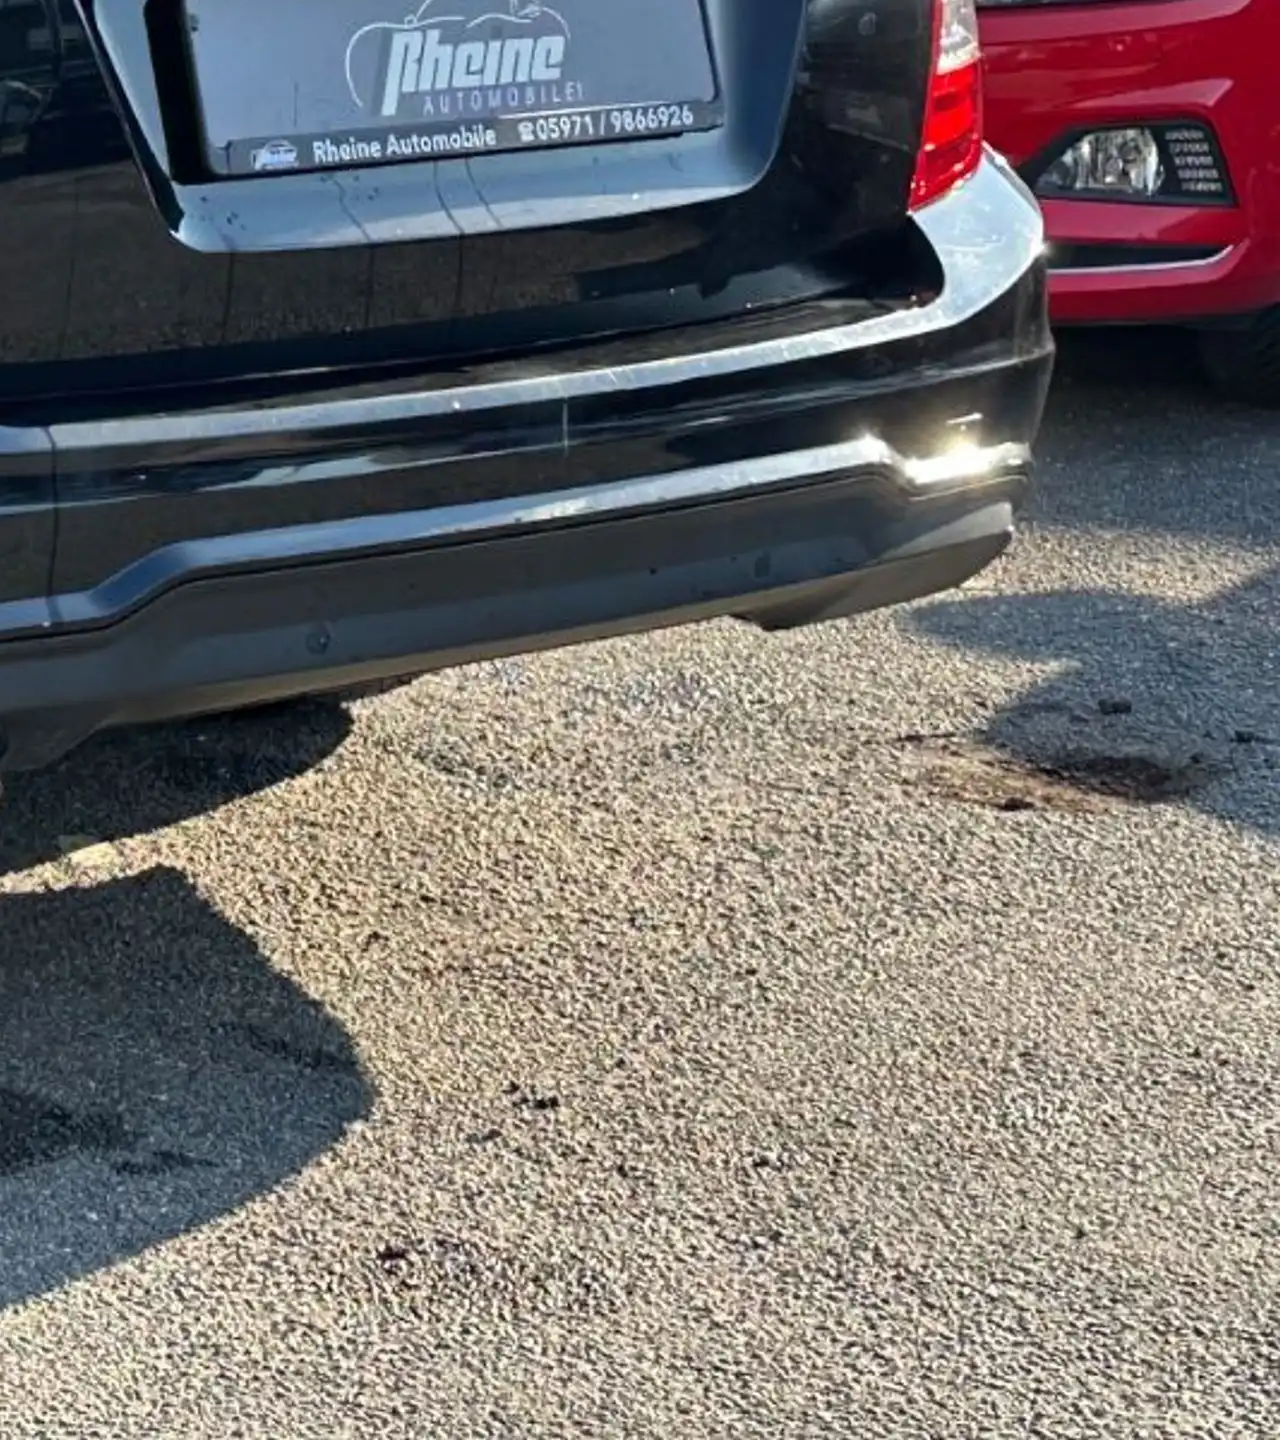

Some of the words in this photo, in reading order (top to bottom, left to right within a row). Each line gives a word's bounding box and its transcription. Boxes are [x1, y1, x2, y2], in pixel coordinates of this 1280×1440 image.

[381, 29, 565, 116] Rheine
[312, 137, 382, 163] Rheine
[386, 124, 496, 156] Automobile
